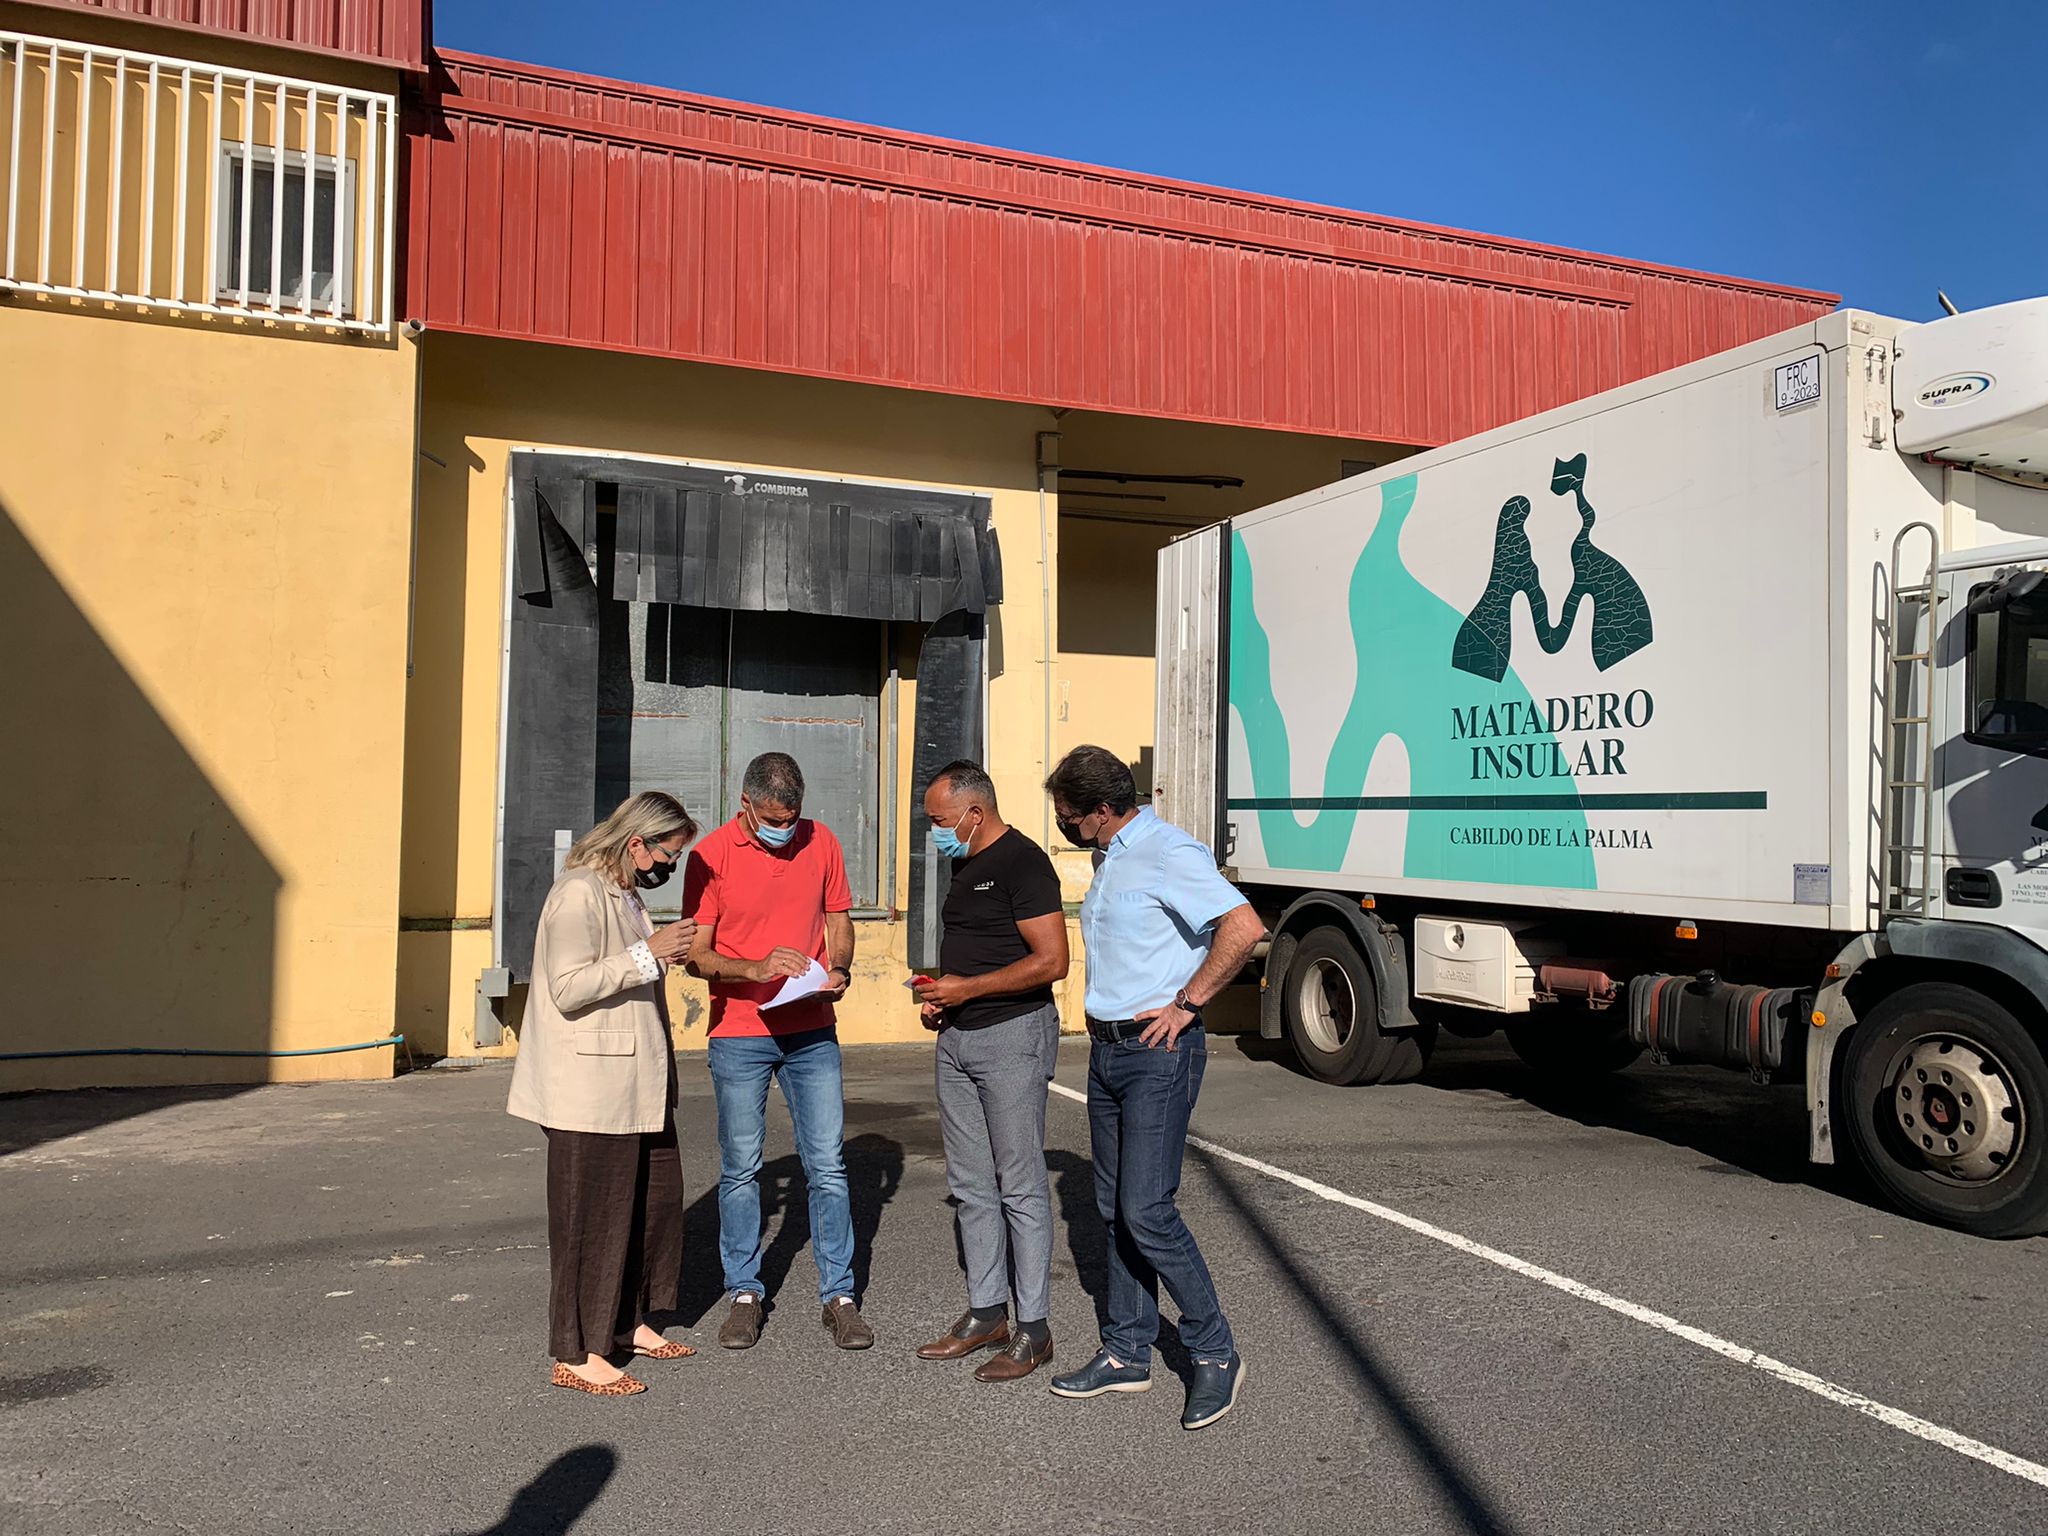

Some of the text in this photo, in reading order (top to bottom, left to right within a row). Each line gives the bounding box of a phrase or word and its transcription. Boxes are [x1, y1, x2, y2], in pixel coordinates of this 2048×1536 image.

[1786, 362, 1808, 391] FRC
[1921, 383, 1973, 401] SUPRA
[754, 482, 809, 497] COMBURSA
[1450, 688, 1655, 740] MATADERO
[1469, 738, 1628, 780] INSULAR
[1450, 826, 1654, 849] CABILDO DE LA PALMA
